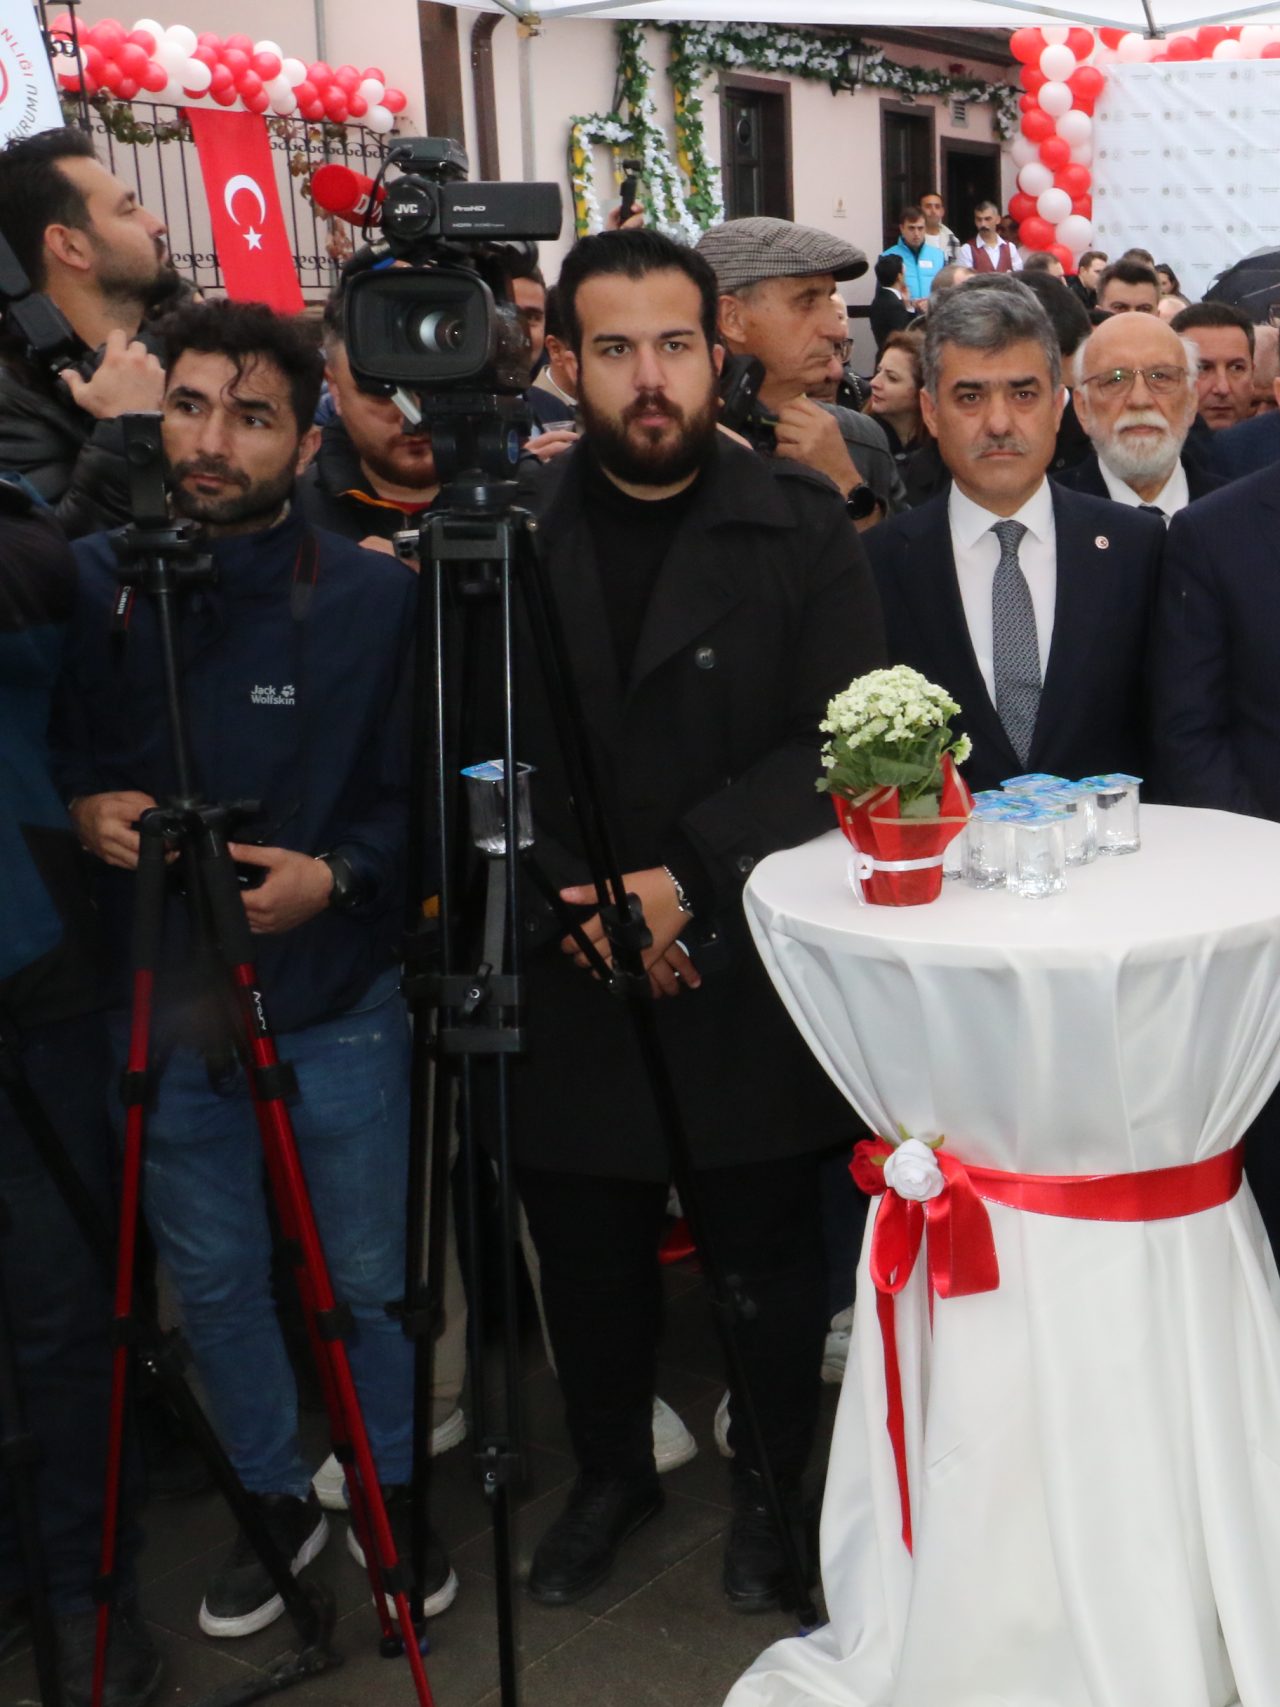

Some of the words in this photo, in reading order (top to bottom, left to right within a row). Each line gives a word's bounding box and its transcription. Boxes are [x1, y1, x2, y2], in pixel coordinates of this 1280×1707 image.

[394, 203, 418, 214] JVC
[117, 585, 131, 615] Canon
[250, 684, 276, 696] Jack
[250, 694, 296, 705] Wolfskin
